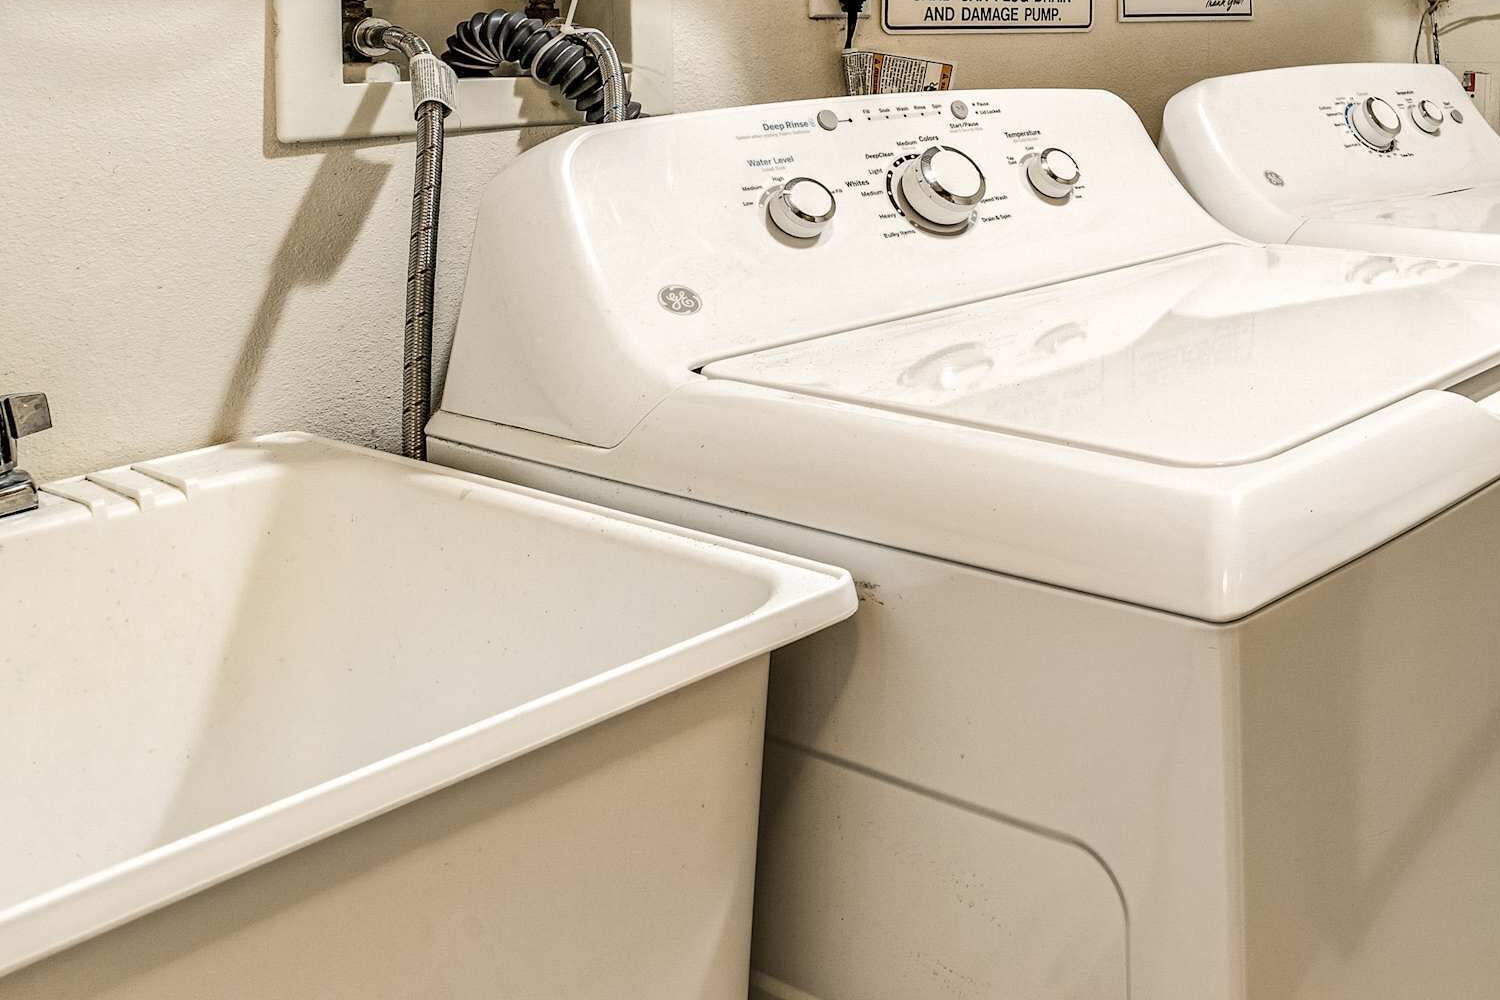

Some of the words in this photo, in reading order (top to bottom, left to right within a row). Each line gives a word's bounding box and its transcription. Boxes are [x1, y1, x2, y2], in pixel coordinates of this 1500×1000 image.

[924, 6, 955, 22] AND
[961, 6, 1019, 22] DAMAGE
[1024, 7, 1062, 21] PUMP.
[762, 123, 785, 131] Deep
[785, 121, 809, 129] Rinse
[1004, 130, 1041, 139] Temperature
[746, 159, 771, 167] Water
[773, 155, 794, 164] Level
